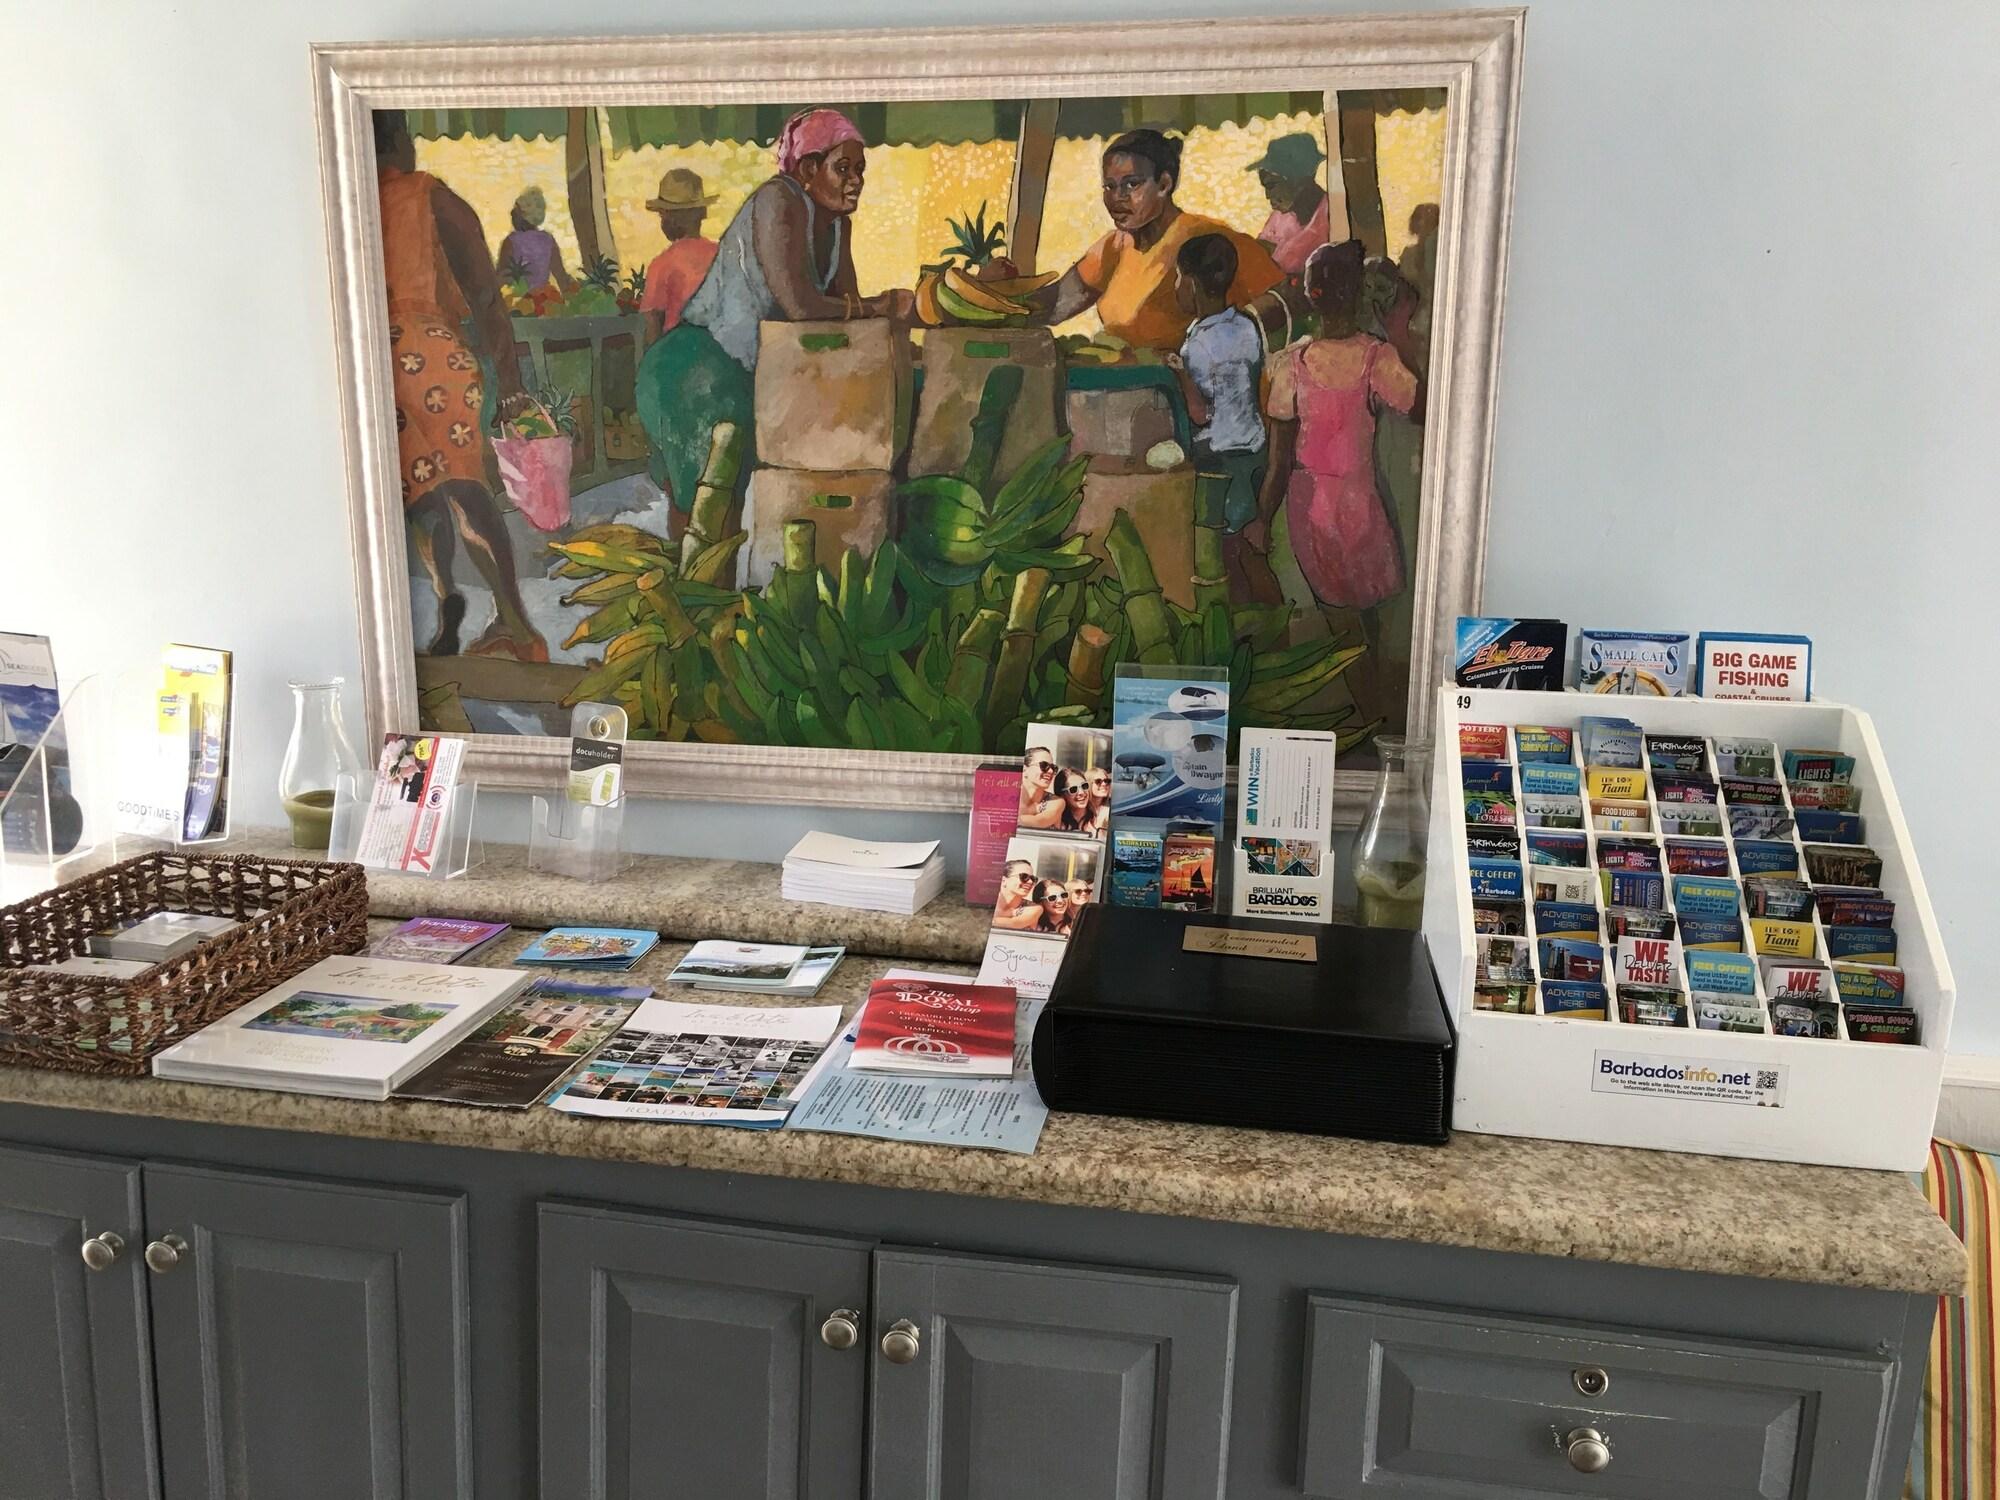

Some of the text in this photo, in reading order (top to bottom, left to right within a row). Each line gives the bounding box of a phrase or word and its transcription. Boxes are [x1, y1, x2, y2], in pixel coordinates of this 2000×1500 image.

[1472, 642, 1499, 665] El
[1506, 640, 1554, 661] Tigre
[1712, 652, 1797, 670] BIG GAME
[1465, 670, 1498, 682] Catamaran
[1498, 666, 1520, 674] Sailing
[1718, 671, 1789, 688] FISHING
[1456, 695, 1472, 709] 49
[1458, 724, 1502, 734] POTTERY
[1651, 739, 1703, 754] EARTHWORKS
[1718, 743, 1770, 756] GOLF
[575, 747, 616, 760] docuholder
[1254, 747, 1262, 777] Vacation
[1190, 770, 1224, 781] Dwayne
[1526, 769, 1545, 778] FREE
[1799, 768, 1831, 780] LIGHTS
[1247, 777, 1260, 807] WIN
[1664, 791, 1683, 800] LIGHTS
[1526, 803, 1577, 815] GOLF
[1601, 807, 1618, 816] FOOD
[1662, 808, 1713, 821] GOLF
[1605, 855, 1625, 865] LIGHTS
[1741, 851, 1795, 862] ADVERTISE
[1486, 870, 1517, 880] OFFER!
[1252, 886, 1294, 895] BRILLIANT
[1484, 888, 1515, 896] Barbados
[1681, 887, 1703, 896] FREE
[1248, 894, 1318, 908] BARBADOS
[1541, 910, 1595, 921] ADVERTISE
[419, 919, 481, 931] Barbados
[1553, 920, 1581, 929] HERE!
[1683, 921, 1738, 932] ADVERTISE
[1837, 932, 1893, 943] ADVERTISE
[1266, 946, 1307, 958] Dining
[1634, 940, 1670, 962] WE
[1693, 962, 1714, 971] FREE
[1628, 967, 1670, 984] TASTE
[1694, 971, 1711, 979] Spend
[1787, 970, 1822, 992] WE
[928, 989, 955, 998] The
[1546, 988, 1601, 999] ADVERTISE
[895, 991, 979, 1009] ROYAL
[1558, 999, 1587, 1008] HERE!
[944, 1003, 982, 1015] Shop
[1703, 1007, 1760, 1024] GOLF
[492, 1069, 530, 1079] GUIDE
[1600, 1059, 1751, 1086] Barbadosinfo.net
[1662, 1083, 1682, 1091] above,
[1706, 1085, 1716, 1093] the
[1716, 1086, 1727, 1094] QR
[1727, 1087, 1744, 1095] code,
[1676, 1089, 1704, 1098] brochure
[1704, 1091, 1721, 1099] stand
[1721, 1092, 1733, 1100] and
[625, 1106, 718, 1118] ROAD MAP
